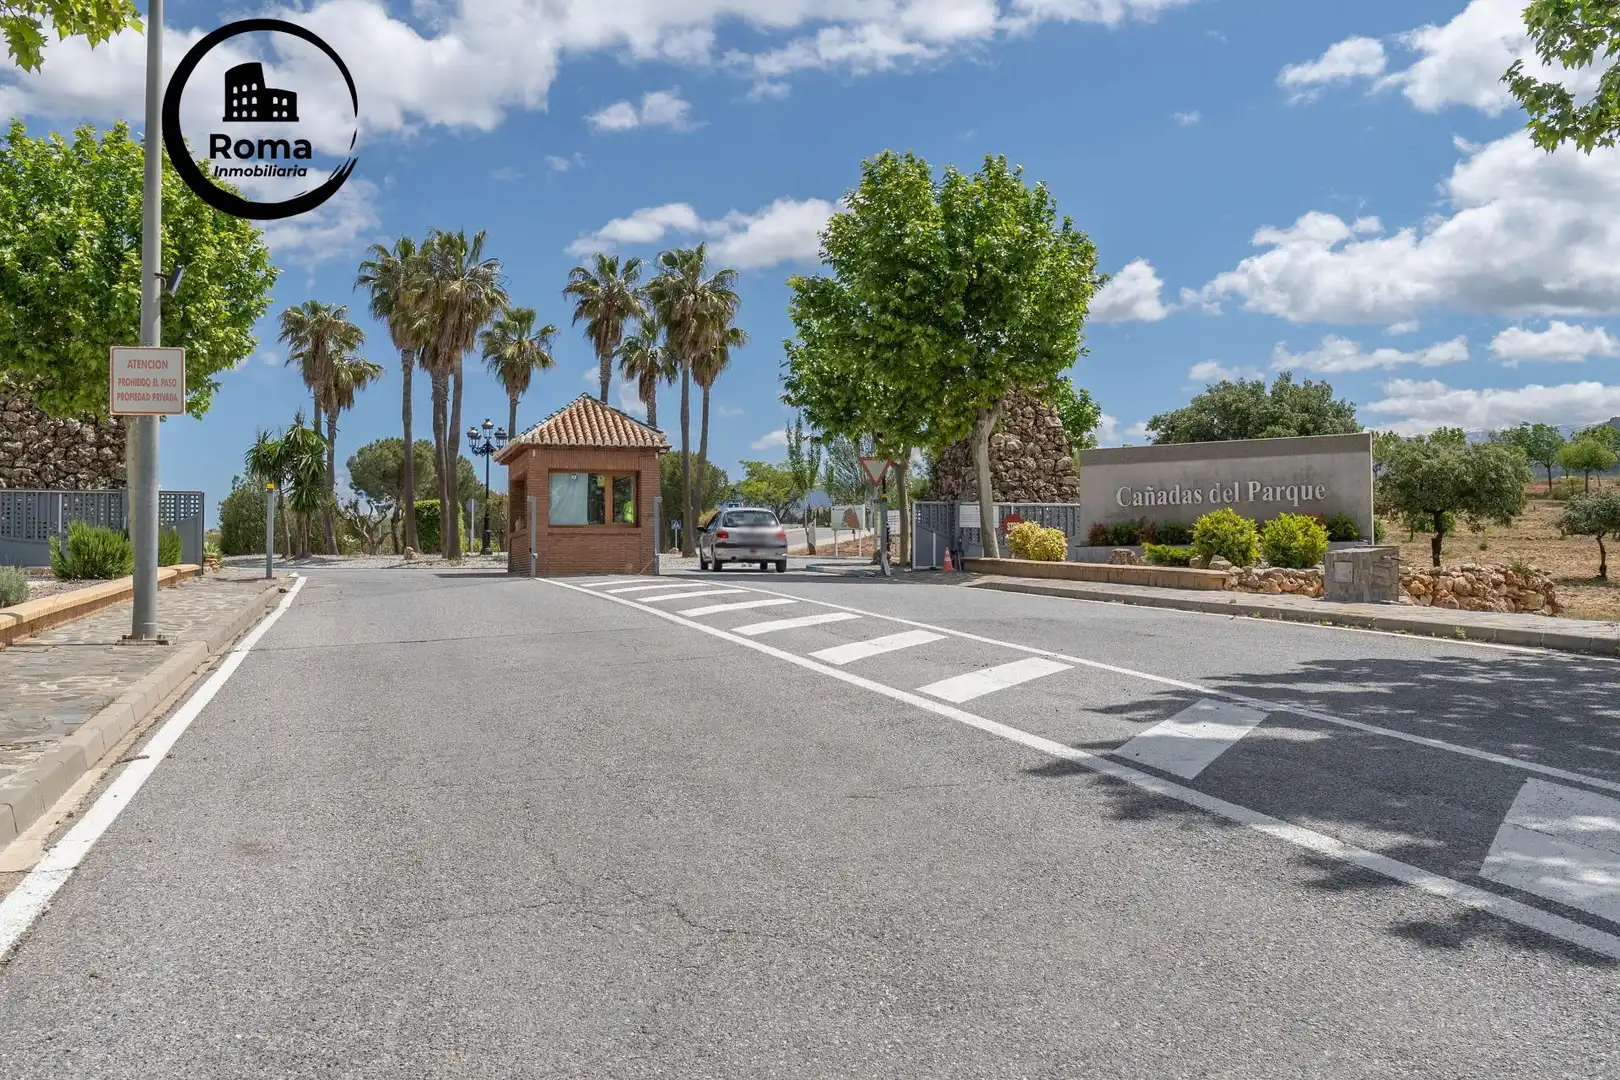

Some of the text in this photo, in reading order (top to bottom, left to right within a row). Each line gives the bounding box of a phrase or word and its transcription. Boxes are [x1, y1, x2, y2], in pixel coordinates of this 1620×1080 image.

[127, 359, 168, 370] ATENCION
[118, 377, 177, 387] PROHIBIDO EL PASO
[116, 392, 178, 402] PROPIEDAD PRIVADA
[1115, 480, 1326, 507] Cañadas del Parque
